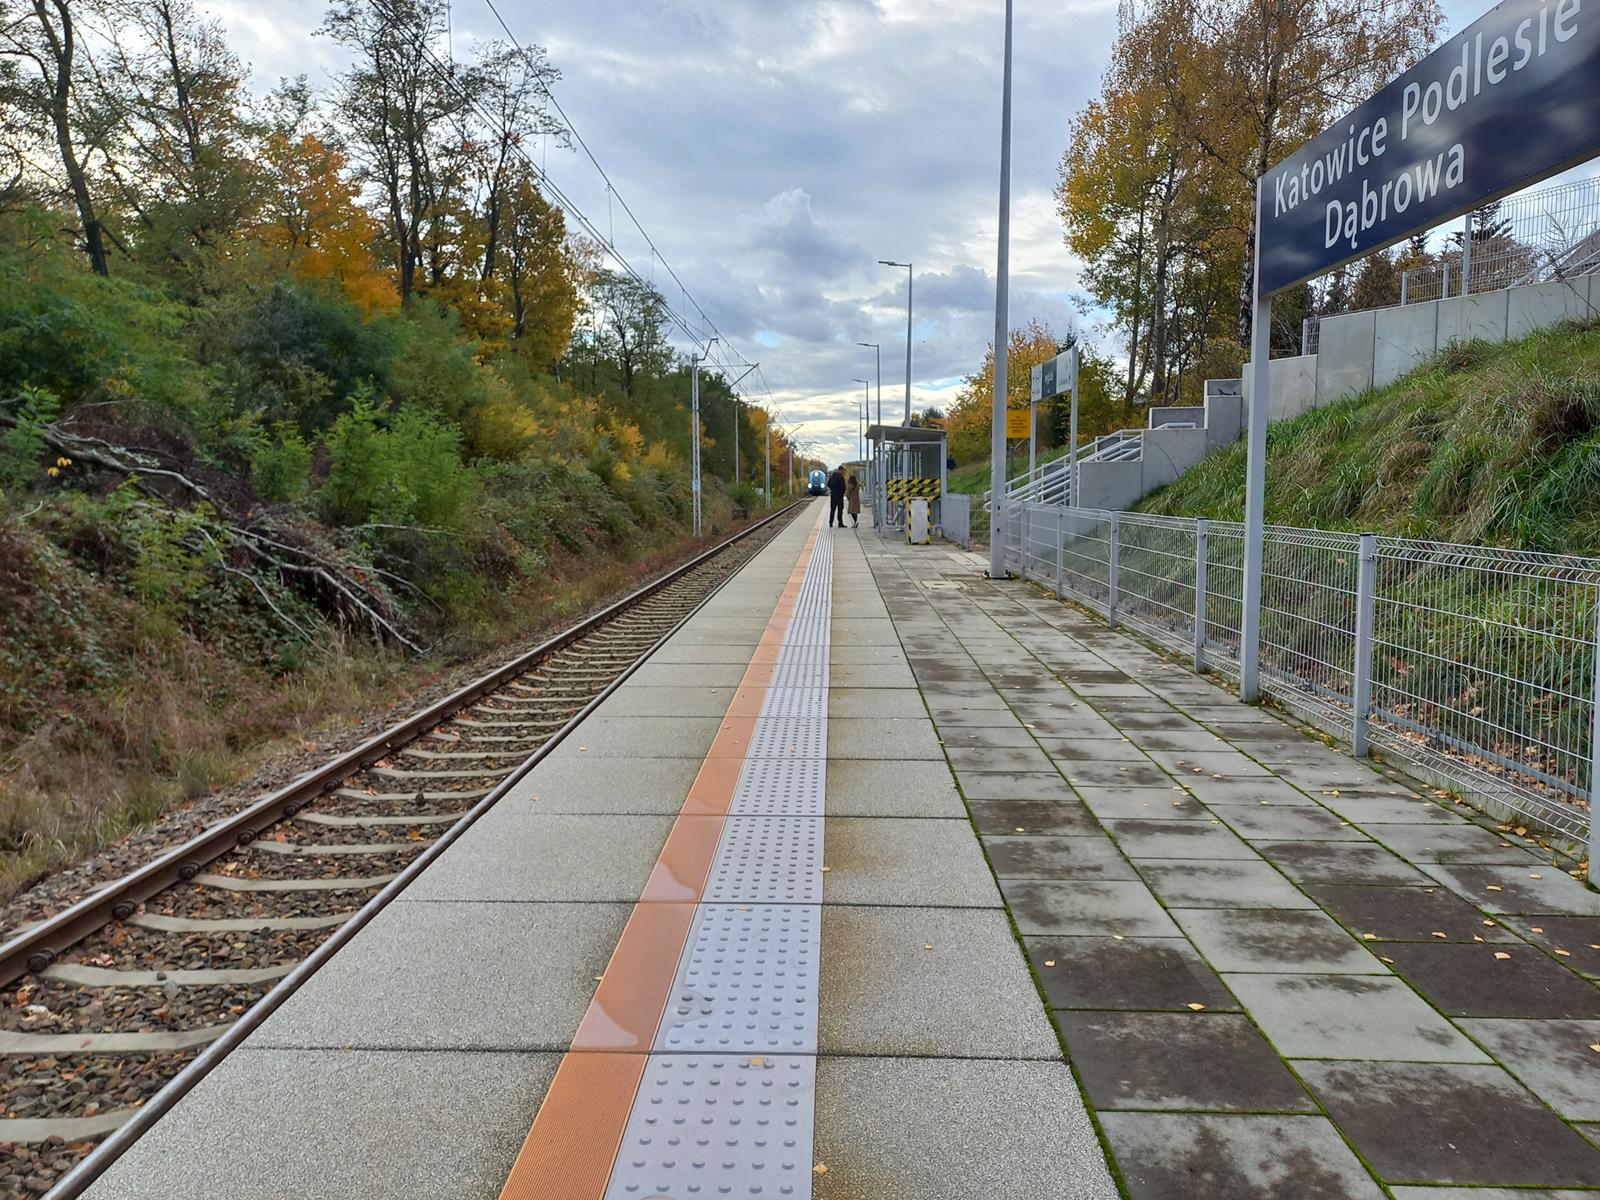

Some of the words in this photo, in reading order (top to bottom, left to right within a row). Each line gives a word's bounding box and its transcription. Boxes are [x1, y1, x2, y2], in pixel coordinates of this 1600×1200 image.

[1274, 117, 1388, 218] Katowice
[1401, 0, 1581, 141] Podlesie
[1325, 143, 1465, 250] Dąbrowa
